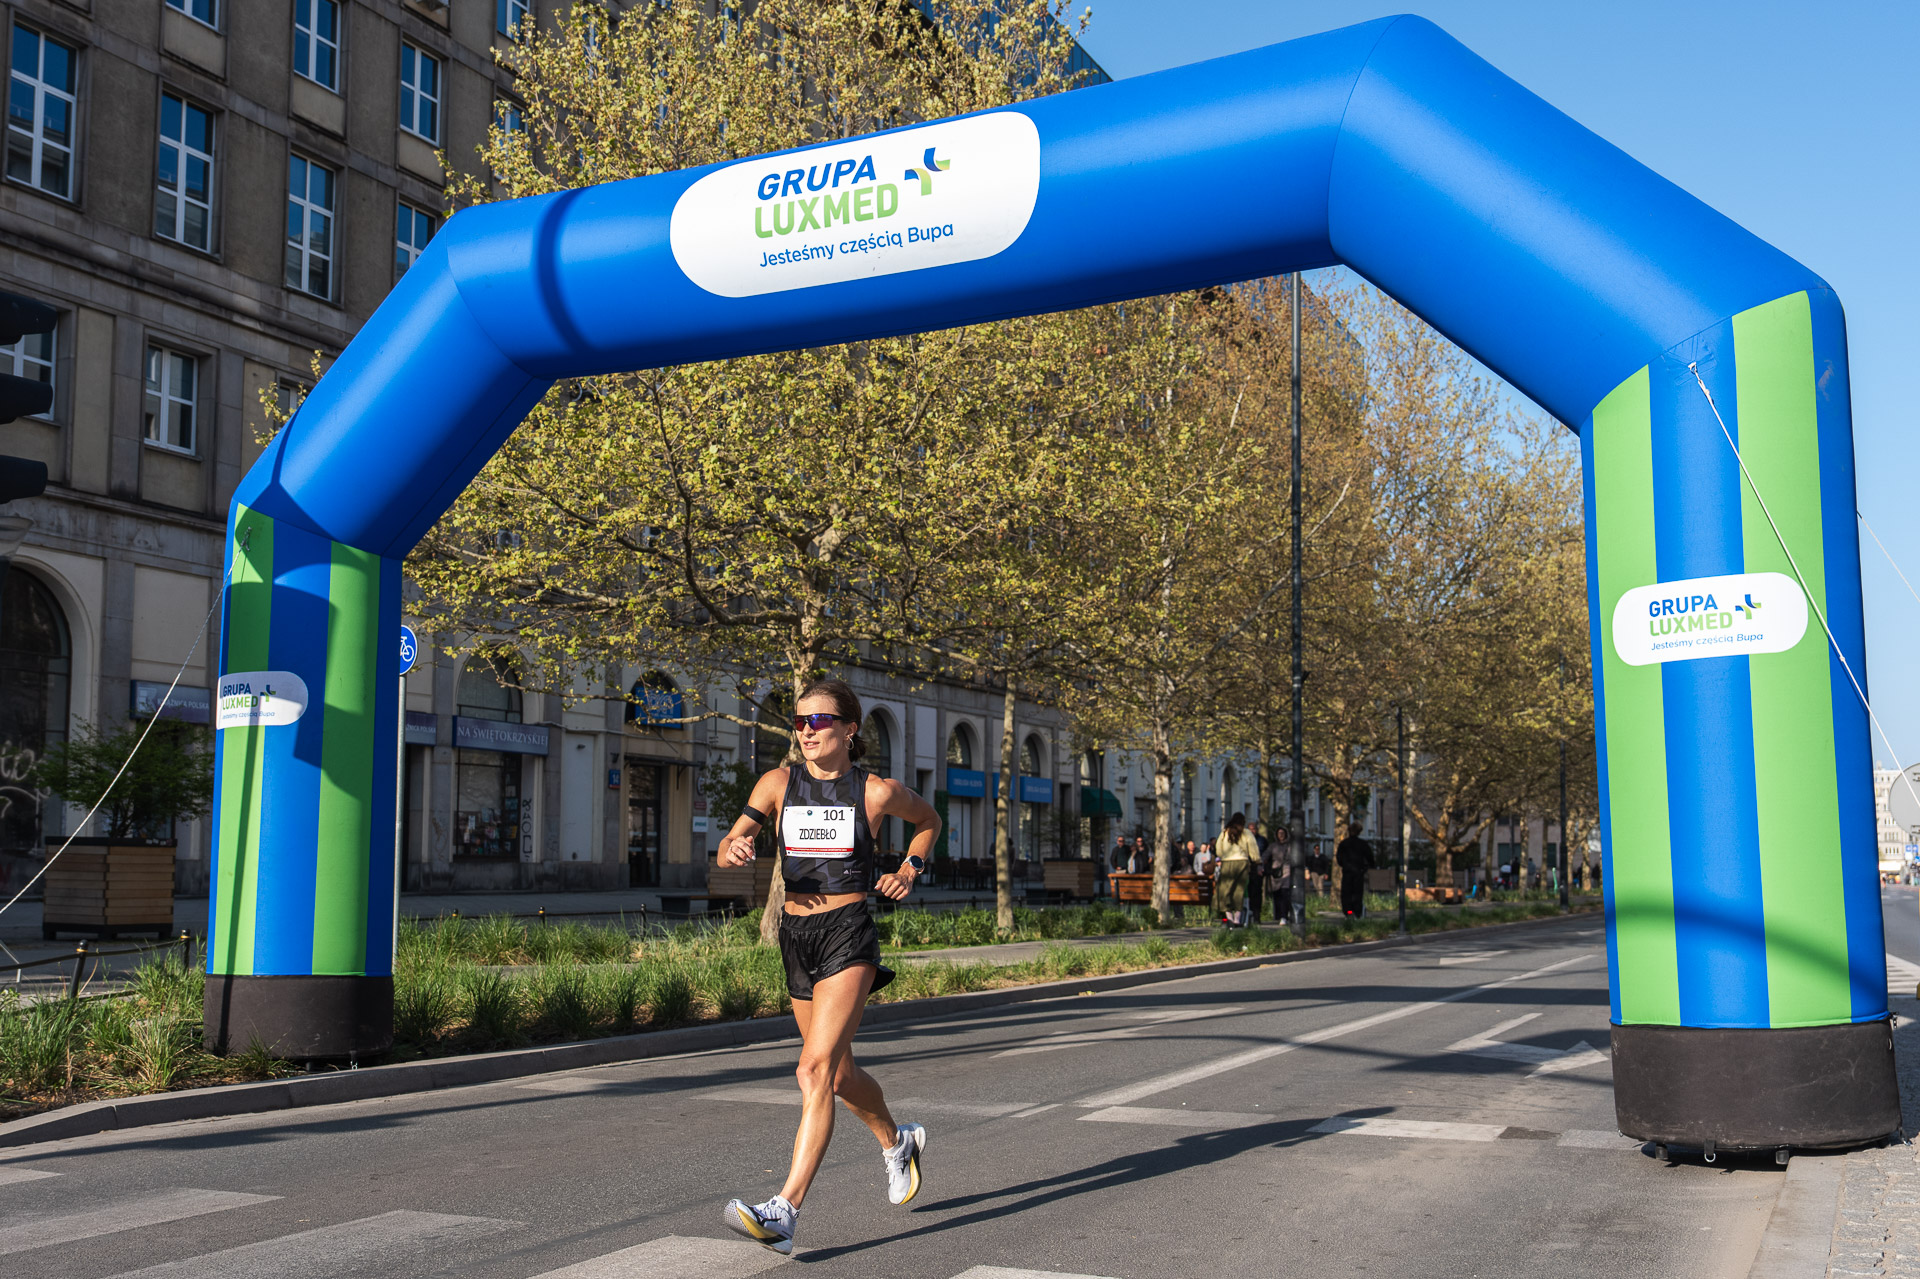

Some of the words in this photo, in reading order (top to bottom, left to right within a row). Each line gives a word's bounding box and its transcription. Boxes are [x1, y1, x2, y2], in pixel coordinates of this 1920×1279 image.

[757, 155, 876, 200] GRUPA
[755, 183, 899, 239] LUXMED
[759, 241, 834, 268] Jesteśmy
[839, 231, 903, 255] częścią
[908, 223, 954, 243] Bupa
[1649, 594, 1718, 617] GRUPA
[1650, 612, 1733, 636] LUXMED
[1651, 639, 1693, 651] Jesteśmy
[1696, 634, 1733, 645] częścią
[1737, 633, 1763, 642] Bupa
[223, 683, 252, 697] GRUPA
[188, 701, 210, 709] POLSKA
[222, 696, 258, 710] LUXMED
[457, 726, 471, 737] NA
[473, 726, 548, 746] ŚWIĘTOKRZYSKIEJ
[823, 809, 845, 821] 101
[799, 828, 837, 840] ZDZIEBŁO
